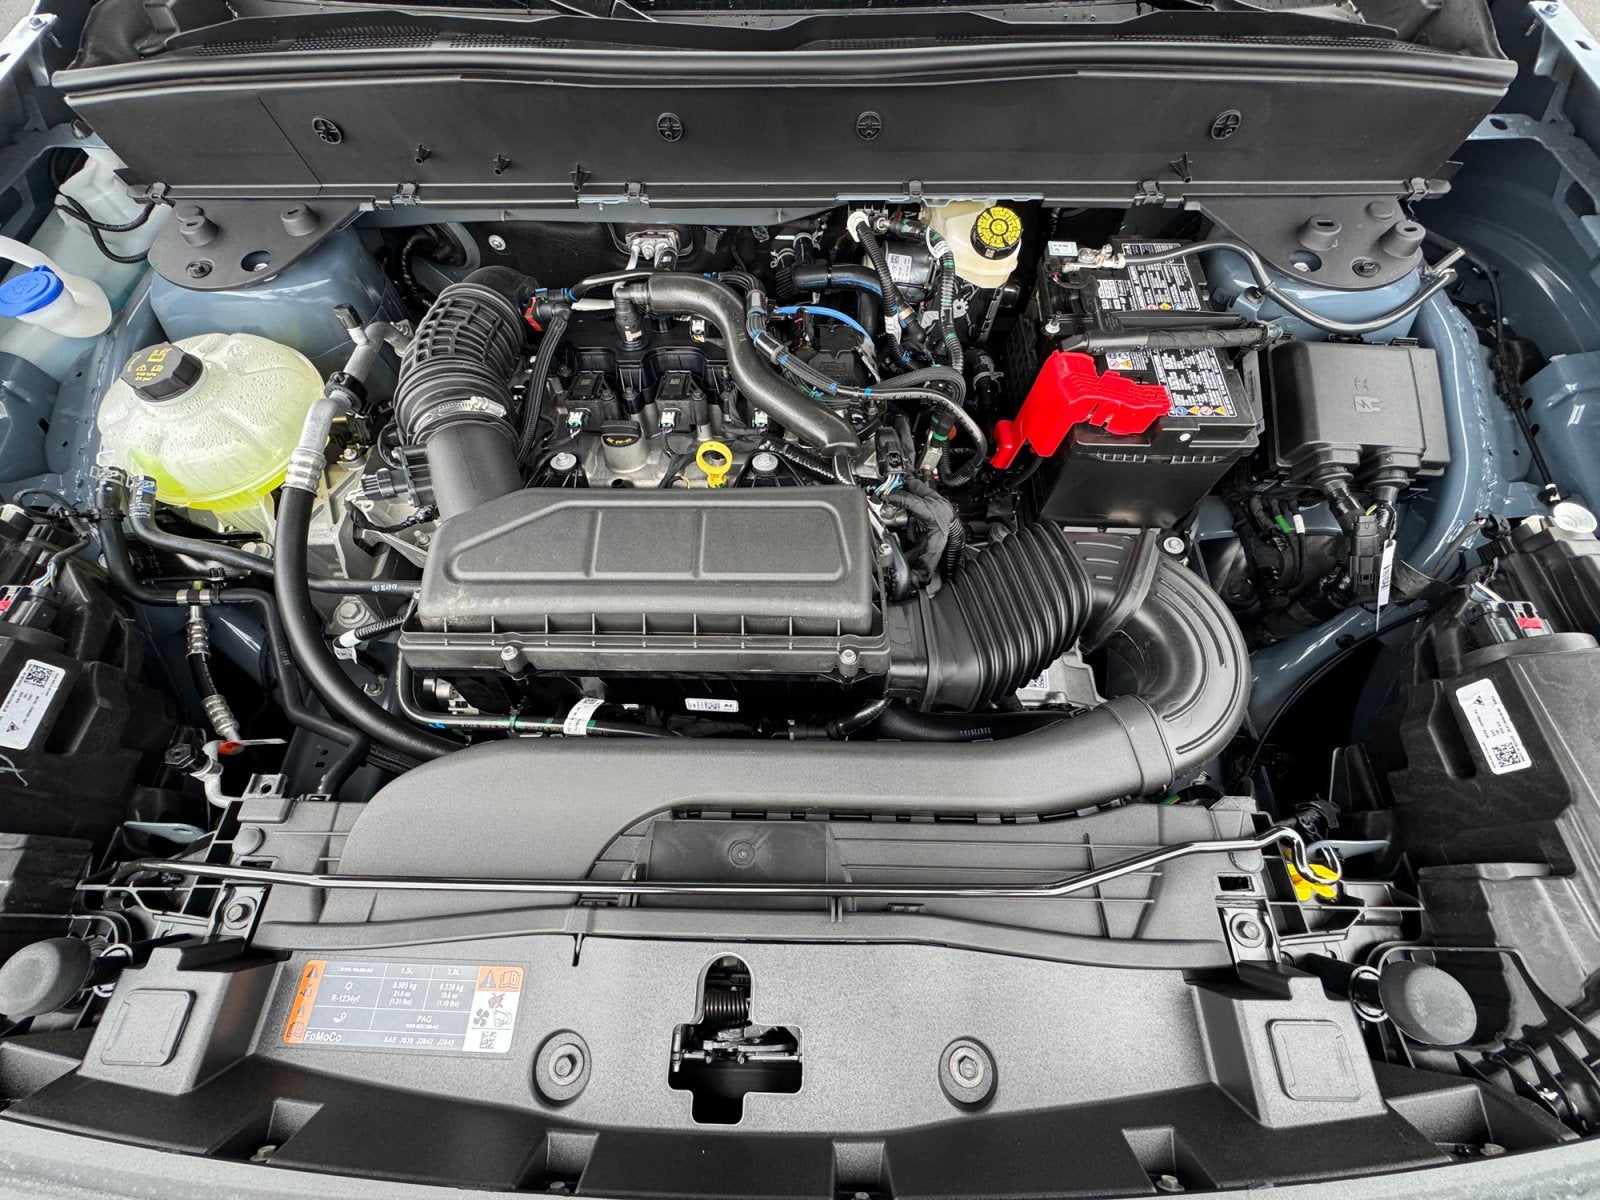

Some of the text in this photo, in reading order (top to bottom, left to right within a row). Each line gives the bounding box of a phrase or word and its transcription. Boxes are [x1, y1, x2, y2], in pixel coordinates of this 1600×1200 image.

[330, 994, 361, 1005] R-1234yf
[416, 1015, 433, 1024] PAG
[304, 1031, 342, 1042] FoMoCo
[383, 1036, 397, 1044] SAE
